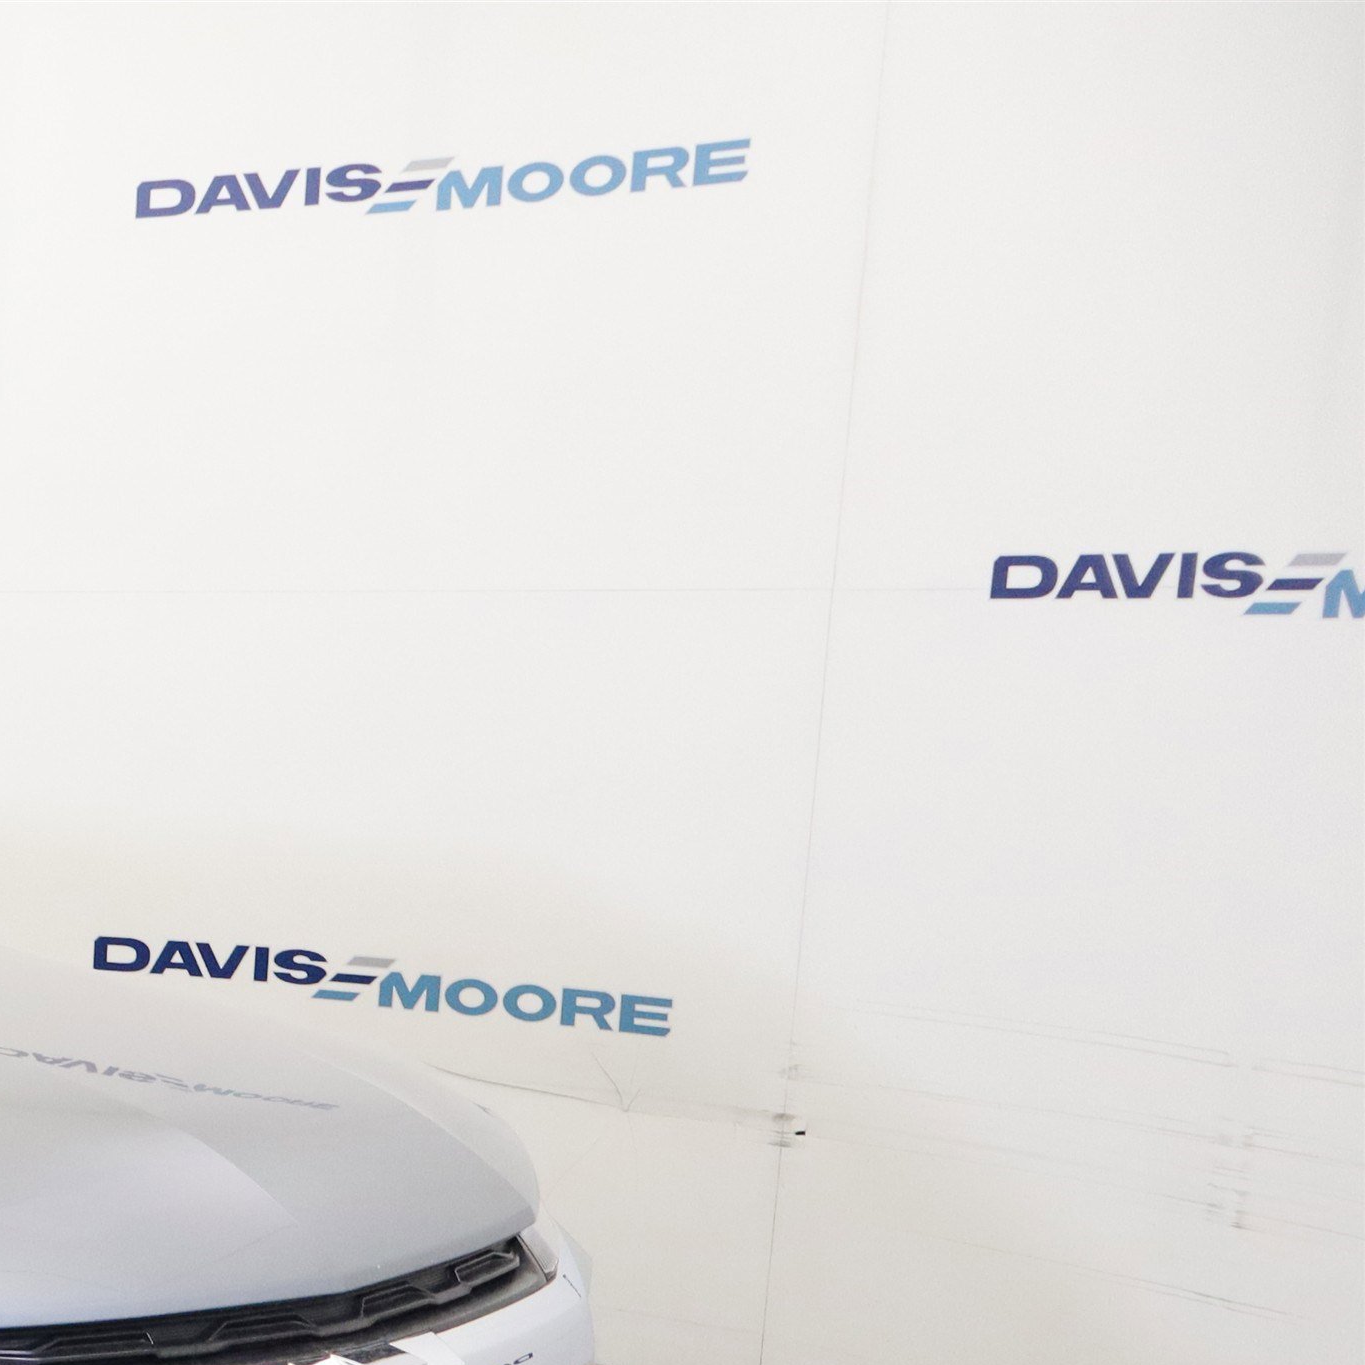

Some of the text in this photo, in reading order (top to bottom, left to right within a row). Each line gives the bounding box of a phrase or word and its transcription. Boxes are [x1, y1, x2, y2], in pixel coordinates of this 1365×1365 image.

[135, 137, 751, 219] DAVIS MOORE
[989, 550, 1267, 600] DAVIS
[94, 935, 673, 1037] DAVIS MOORE
